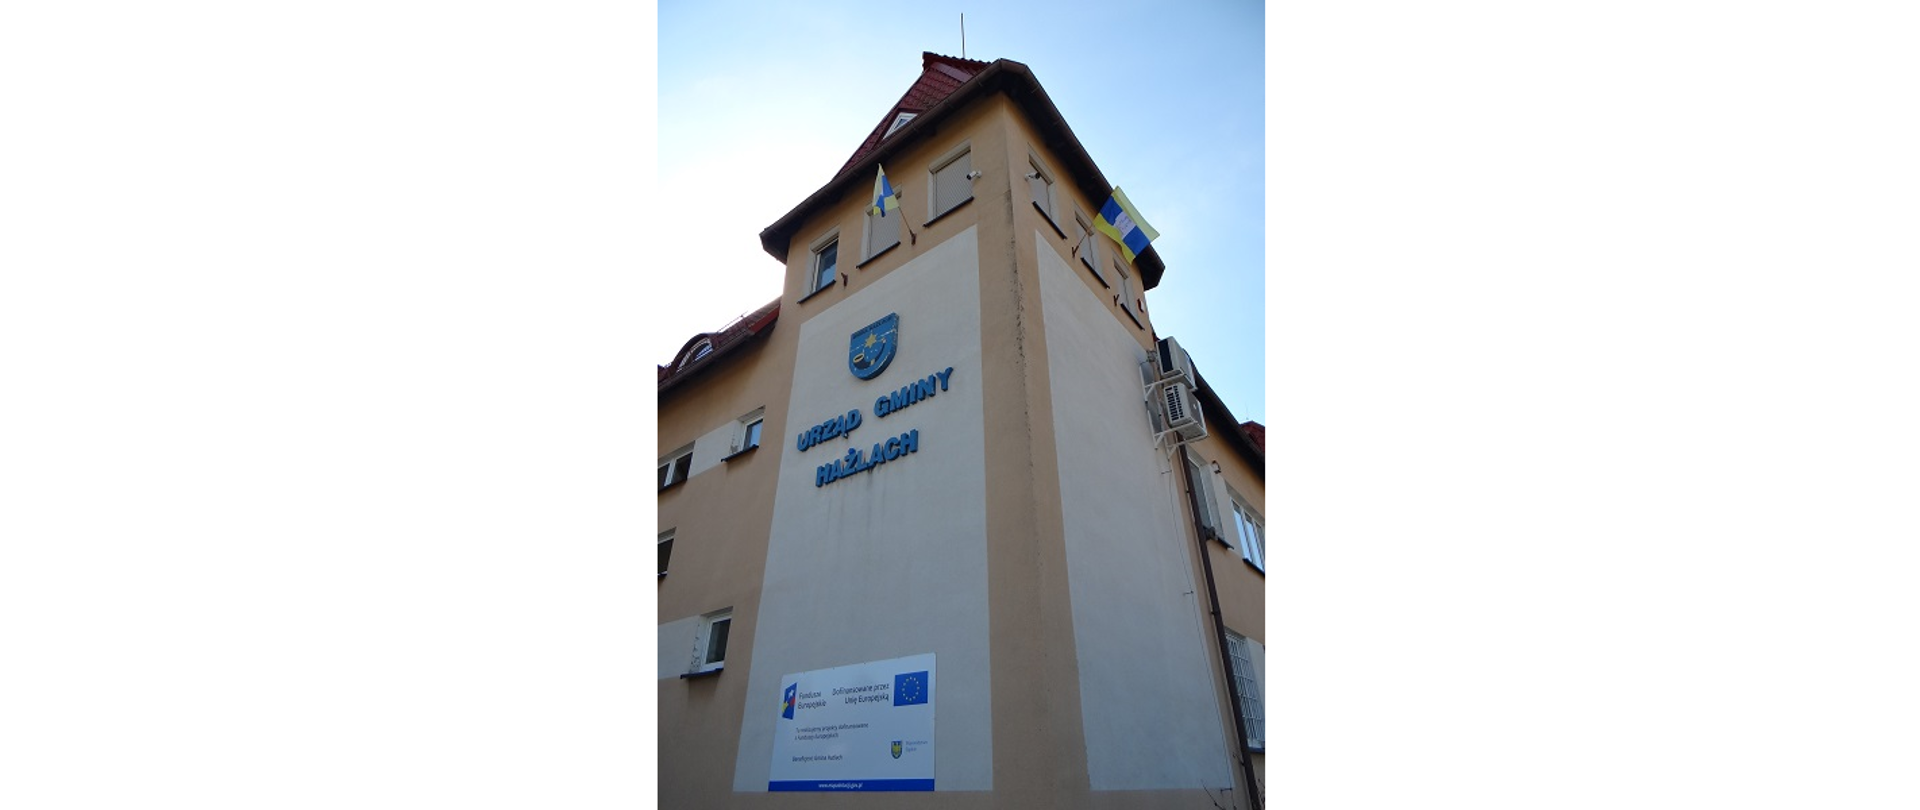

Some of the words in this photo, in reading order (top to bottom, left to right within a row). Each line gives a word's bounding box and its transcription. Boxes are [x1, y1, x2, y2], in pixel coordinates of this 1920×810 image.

[797, 409, 862, 451] URZĄD
[874, 366, 953, 418] GMINY
[815, 428, 918, 487] HAŻLACH
[832, 685, 873, 696] Dofinansowane
[873, 683, 890, 693] przez
[858, 692, 889, 703] Europejską
[798, 699, 827, 710] Europejskie
